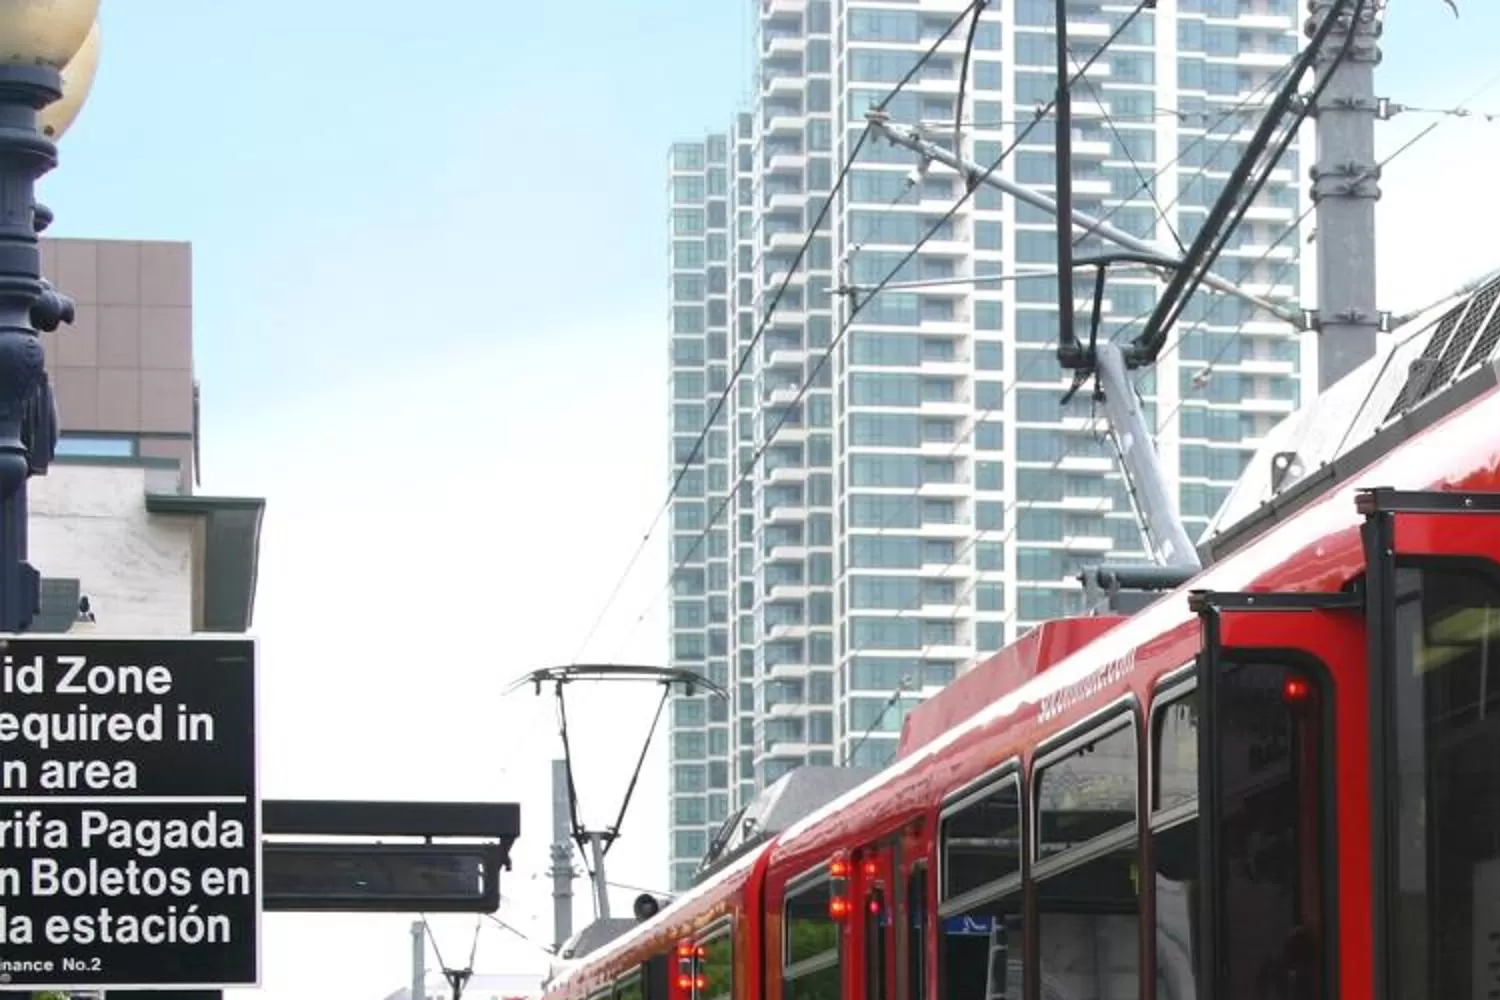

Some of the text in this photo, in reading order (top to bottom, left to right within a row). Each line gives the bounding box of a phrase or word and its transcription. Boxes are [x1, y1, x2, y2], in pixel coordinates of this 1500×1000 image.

[4, 656, 172, 695] id Zone
[0, 704, 214, 749] equired in
[3, 760, 137, 789] n area
[0, 811, 244, 857] rifa Pagada
[32, 858, 192, 897] Boletos
[201, 867, 250, 896] en
[45, 905, 231, 944] estación
[63, 957, 101, 971] No.2
